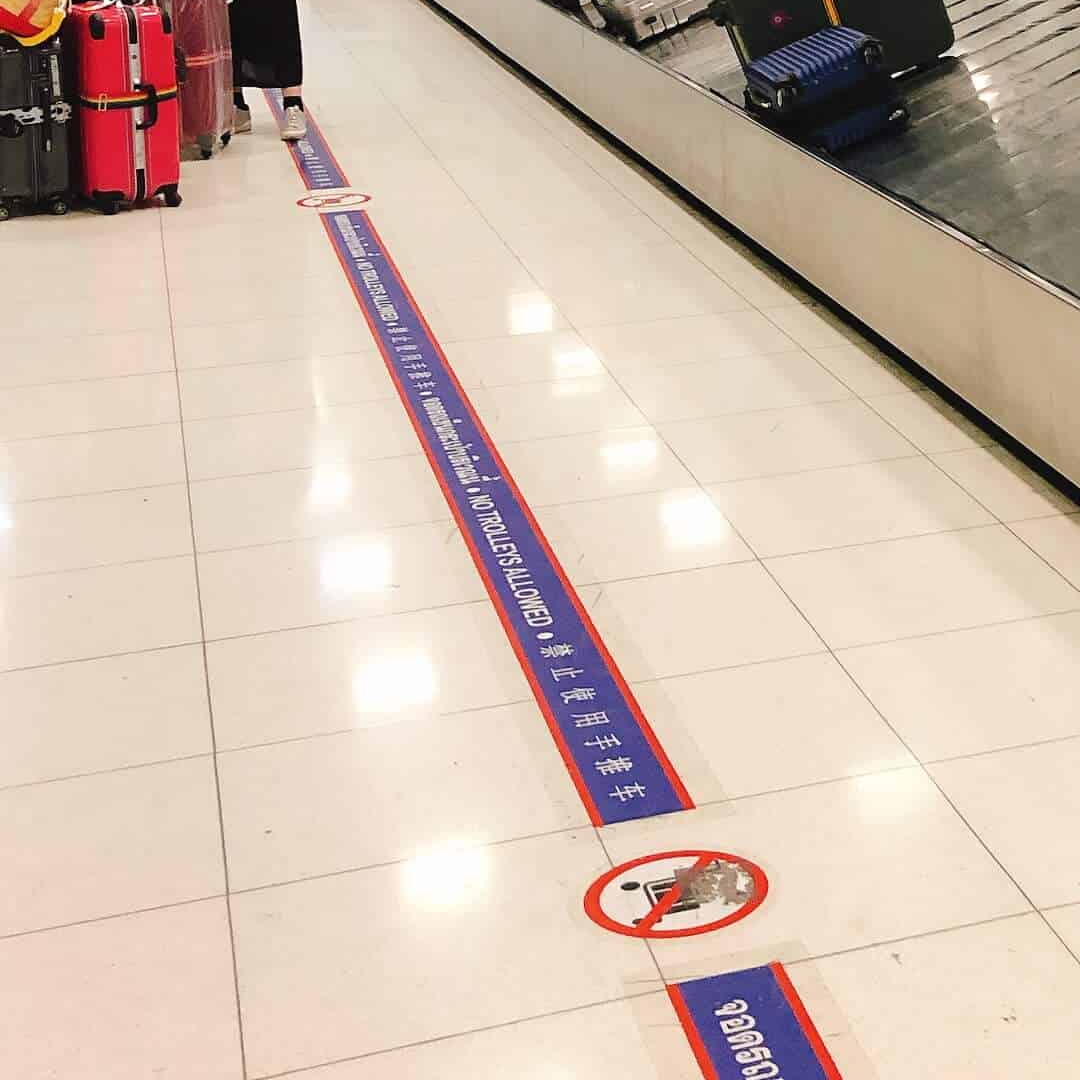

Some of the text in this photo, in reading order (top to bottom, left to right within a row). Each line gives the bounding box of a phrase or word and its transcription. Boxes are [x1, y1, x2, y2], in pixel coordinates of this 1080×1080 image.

[468, 494, 553, 627] NO TROLLEYS ALLOWED
[539, 642, 647, 803] 禁止使用手推车
